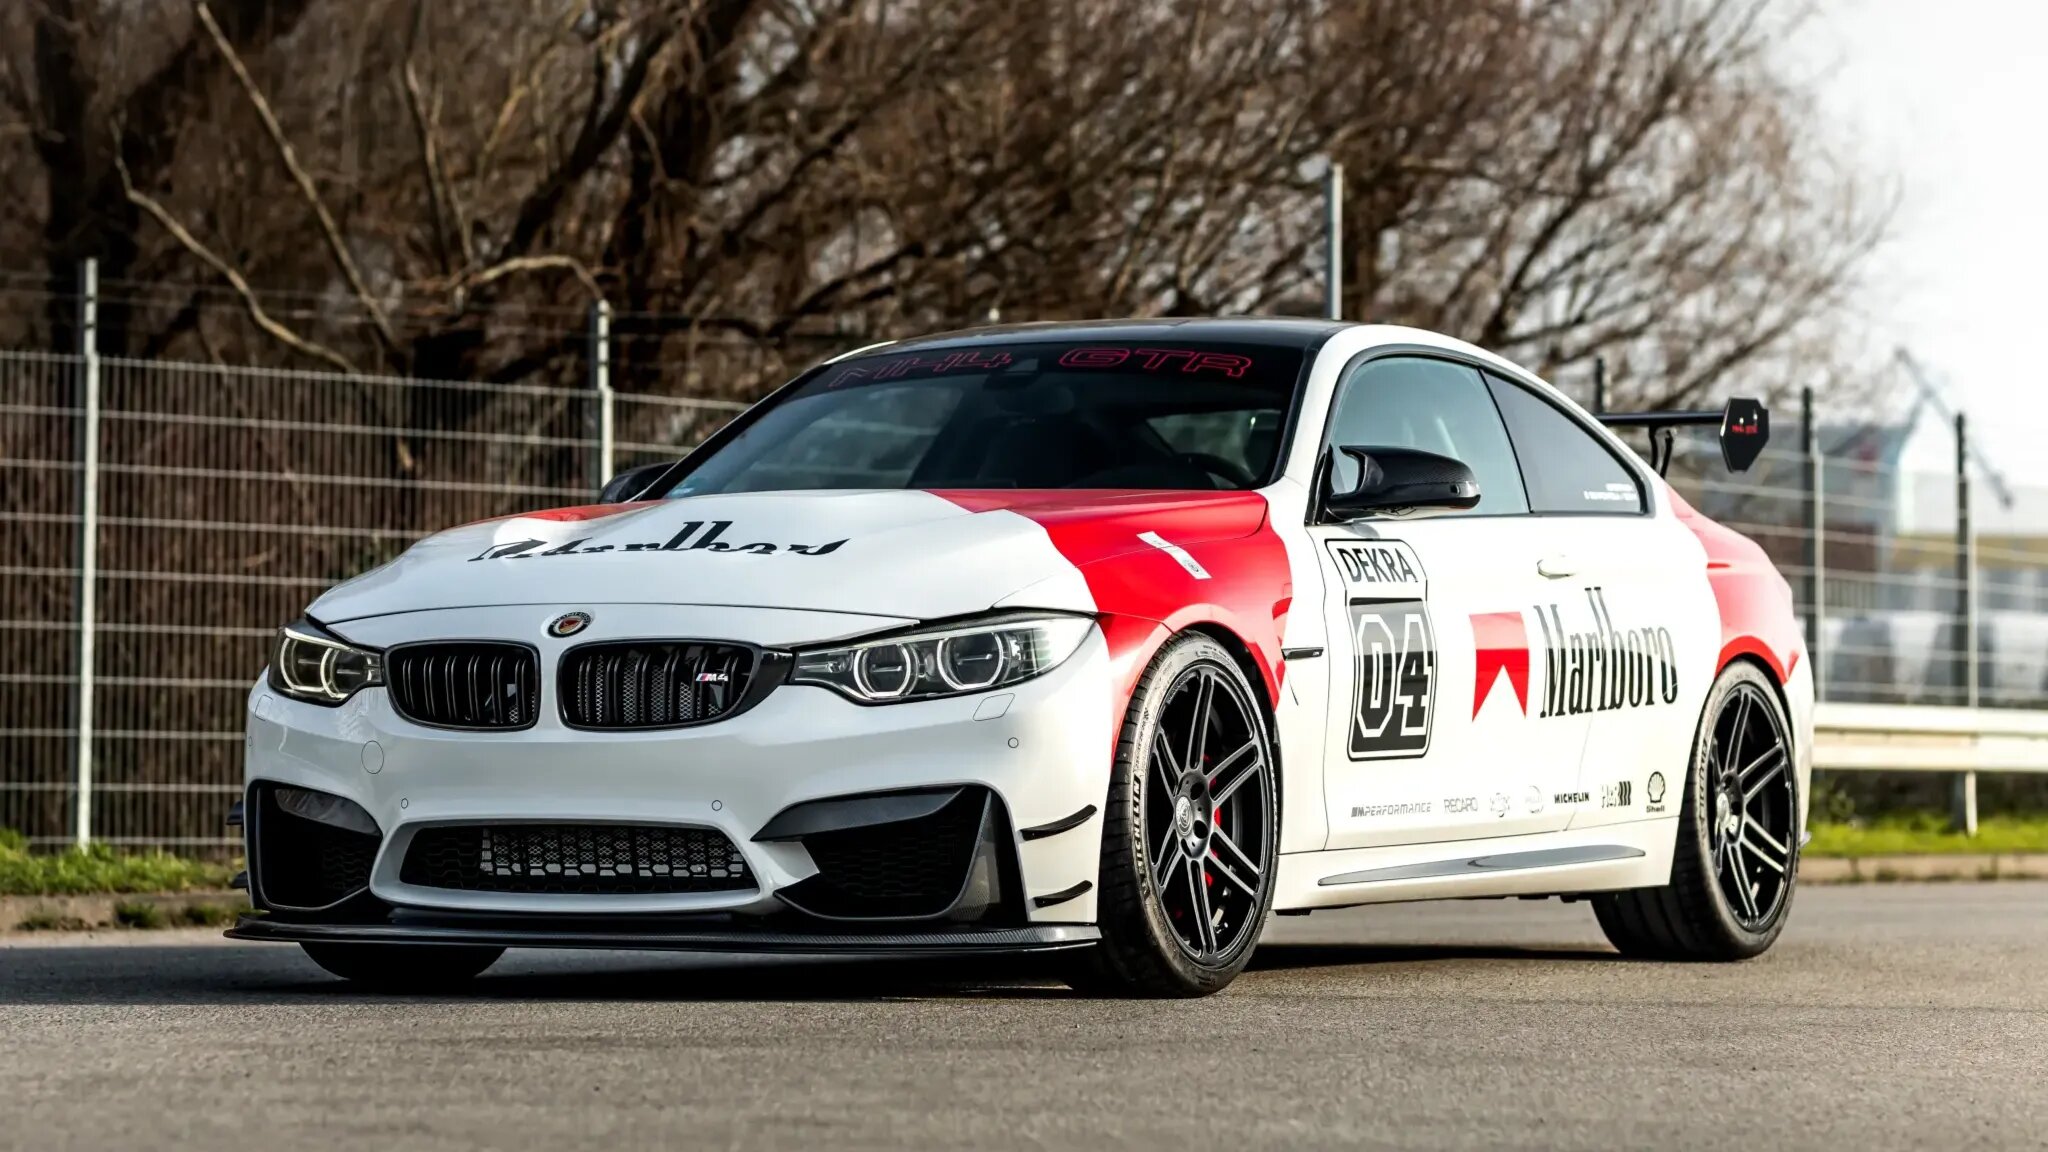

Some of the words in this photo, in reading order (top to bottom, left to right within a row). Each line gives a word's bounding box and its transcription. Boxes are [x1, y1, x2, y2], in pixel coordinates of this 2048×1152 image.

[1058, 348, 1252, 378] GTR
[1336, 547, 1419, 584] DEKRA
[1533, 586, 1679, 719] Marlboro
[1356, 613, 1433, 738] 04
[1443, 797, 1478, 813] RECARO
[1554, 792, 1590, 804] MICHELIN
[1646, 805, 1665, 813] Shell
